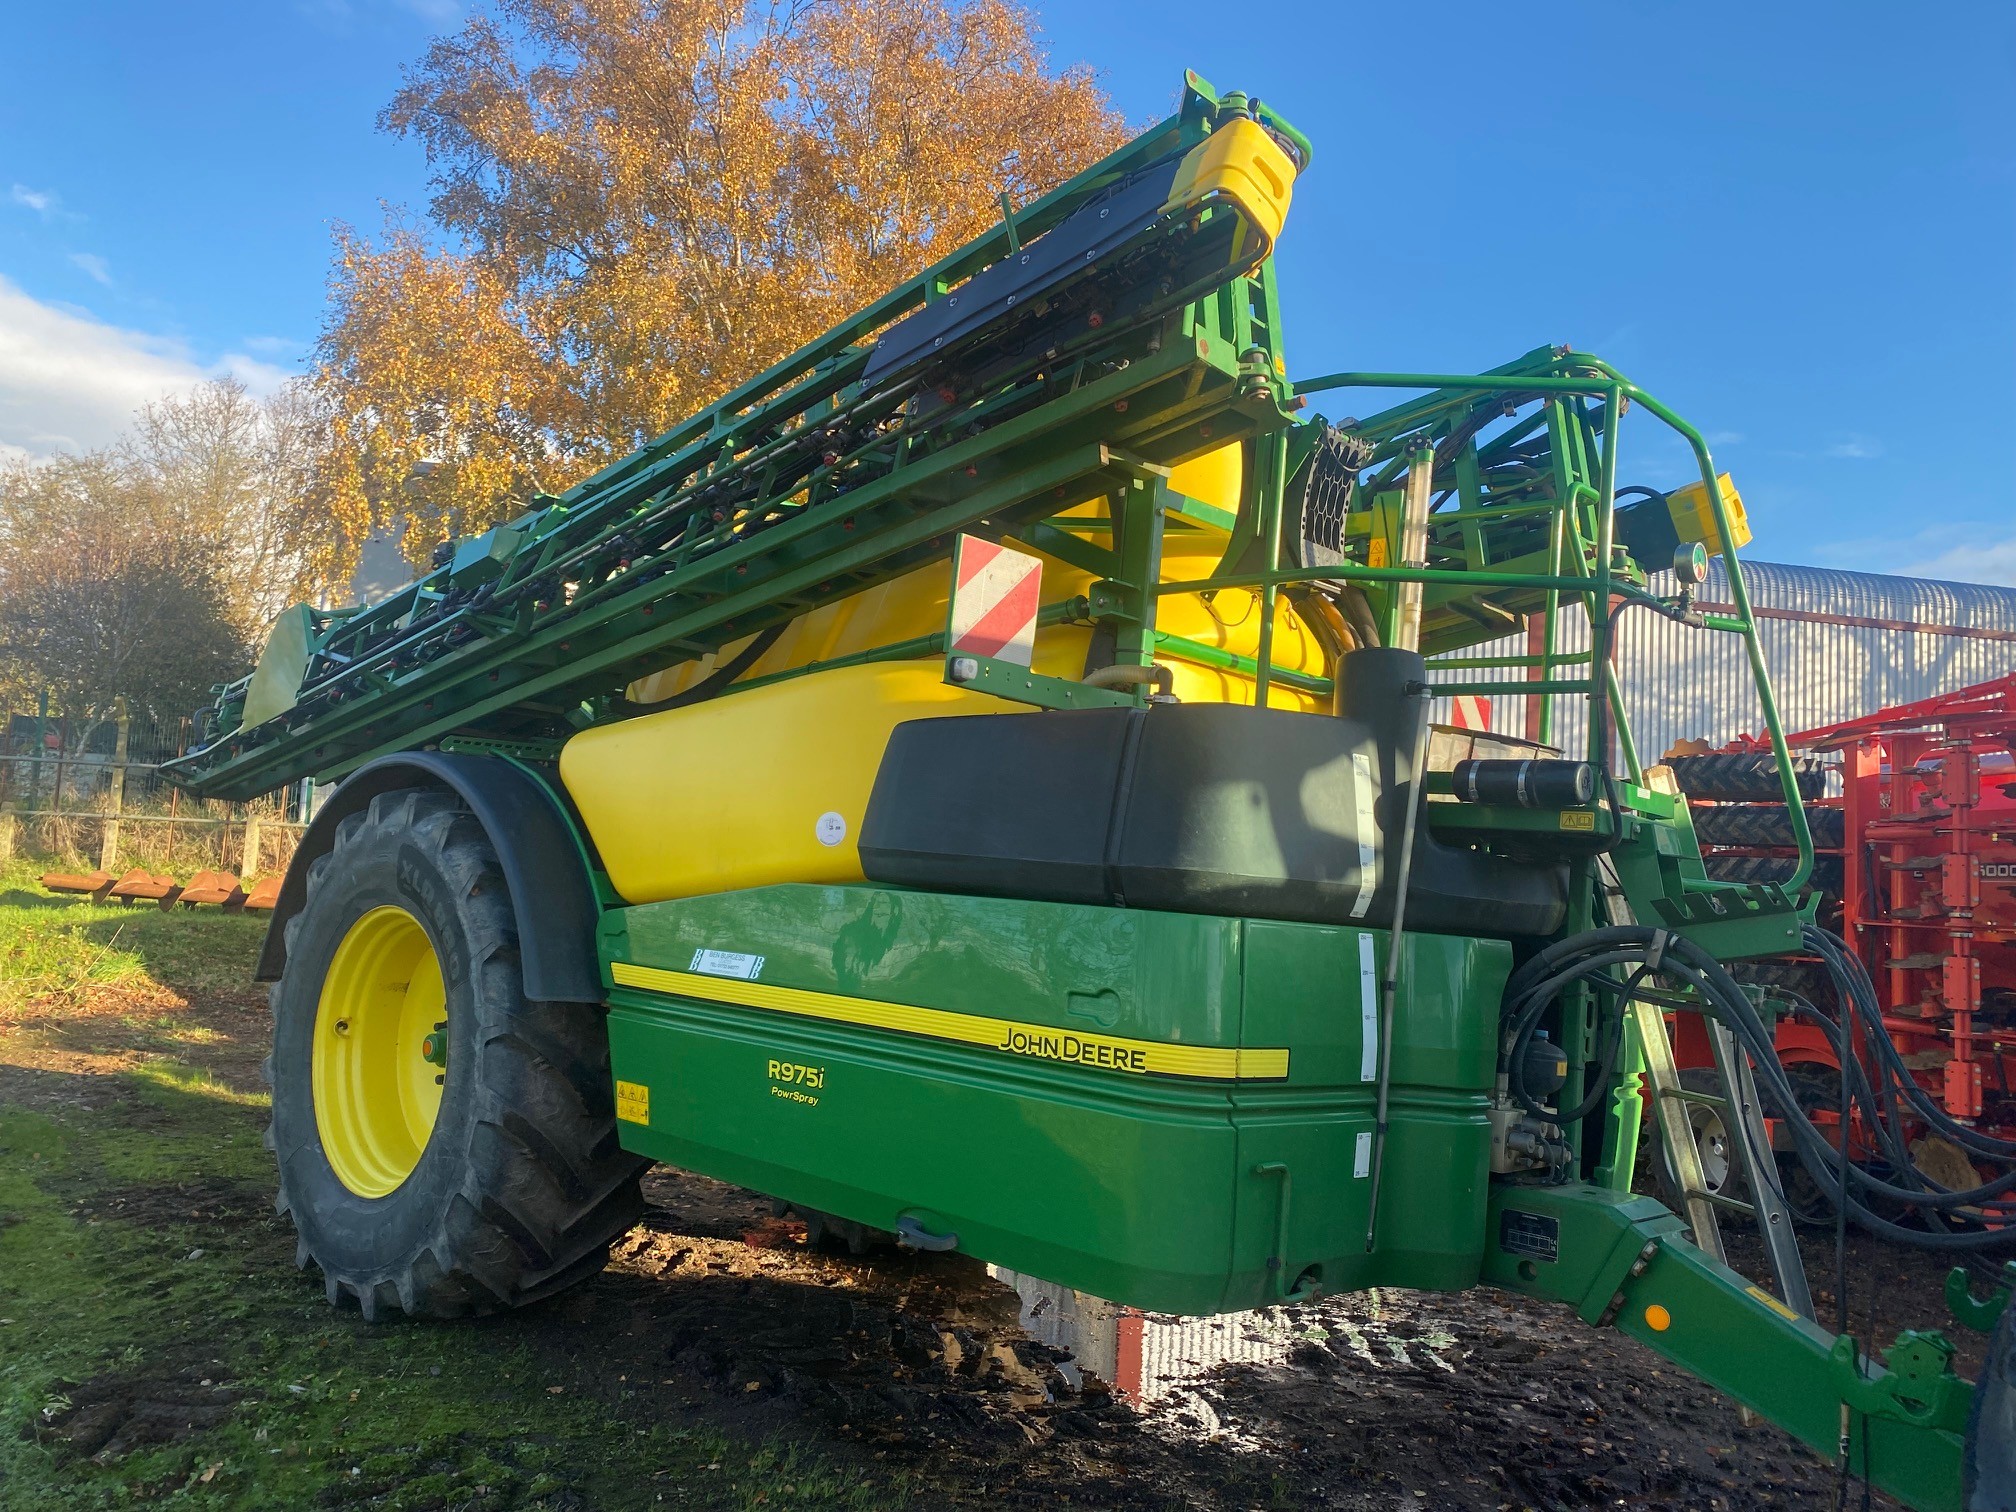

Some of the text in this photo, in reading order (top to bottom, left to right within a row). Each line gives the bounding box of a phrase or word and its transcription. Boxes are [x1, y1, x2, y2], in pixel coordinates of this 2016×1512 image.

[720, 952, 746, 962] BURGESS
[1000, 1027, 1146, 1070] JOHN DEERE
[768, 1059, 825, 1089] R975i
[771, 1086, 819, 1107] PowrSpray
